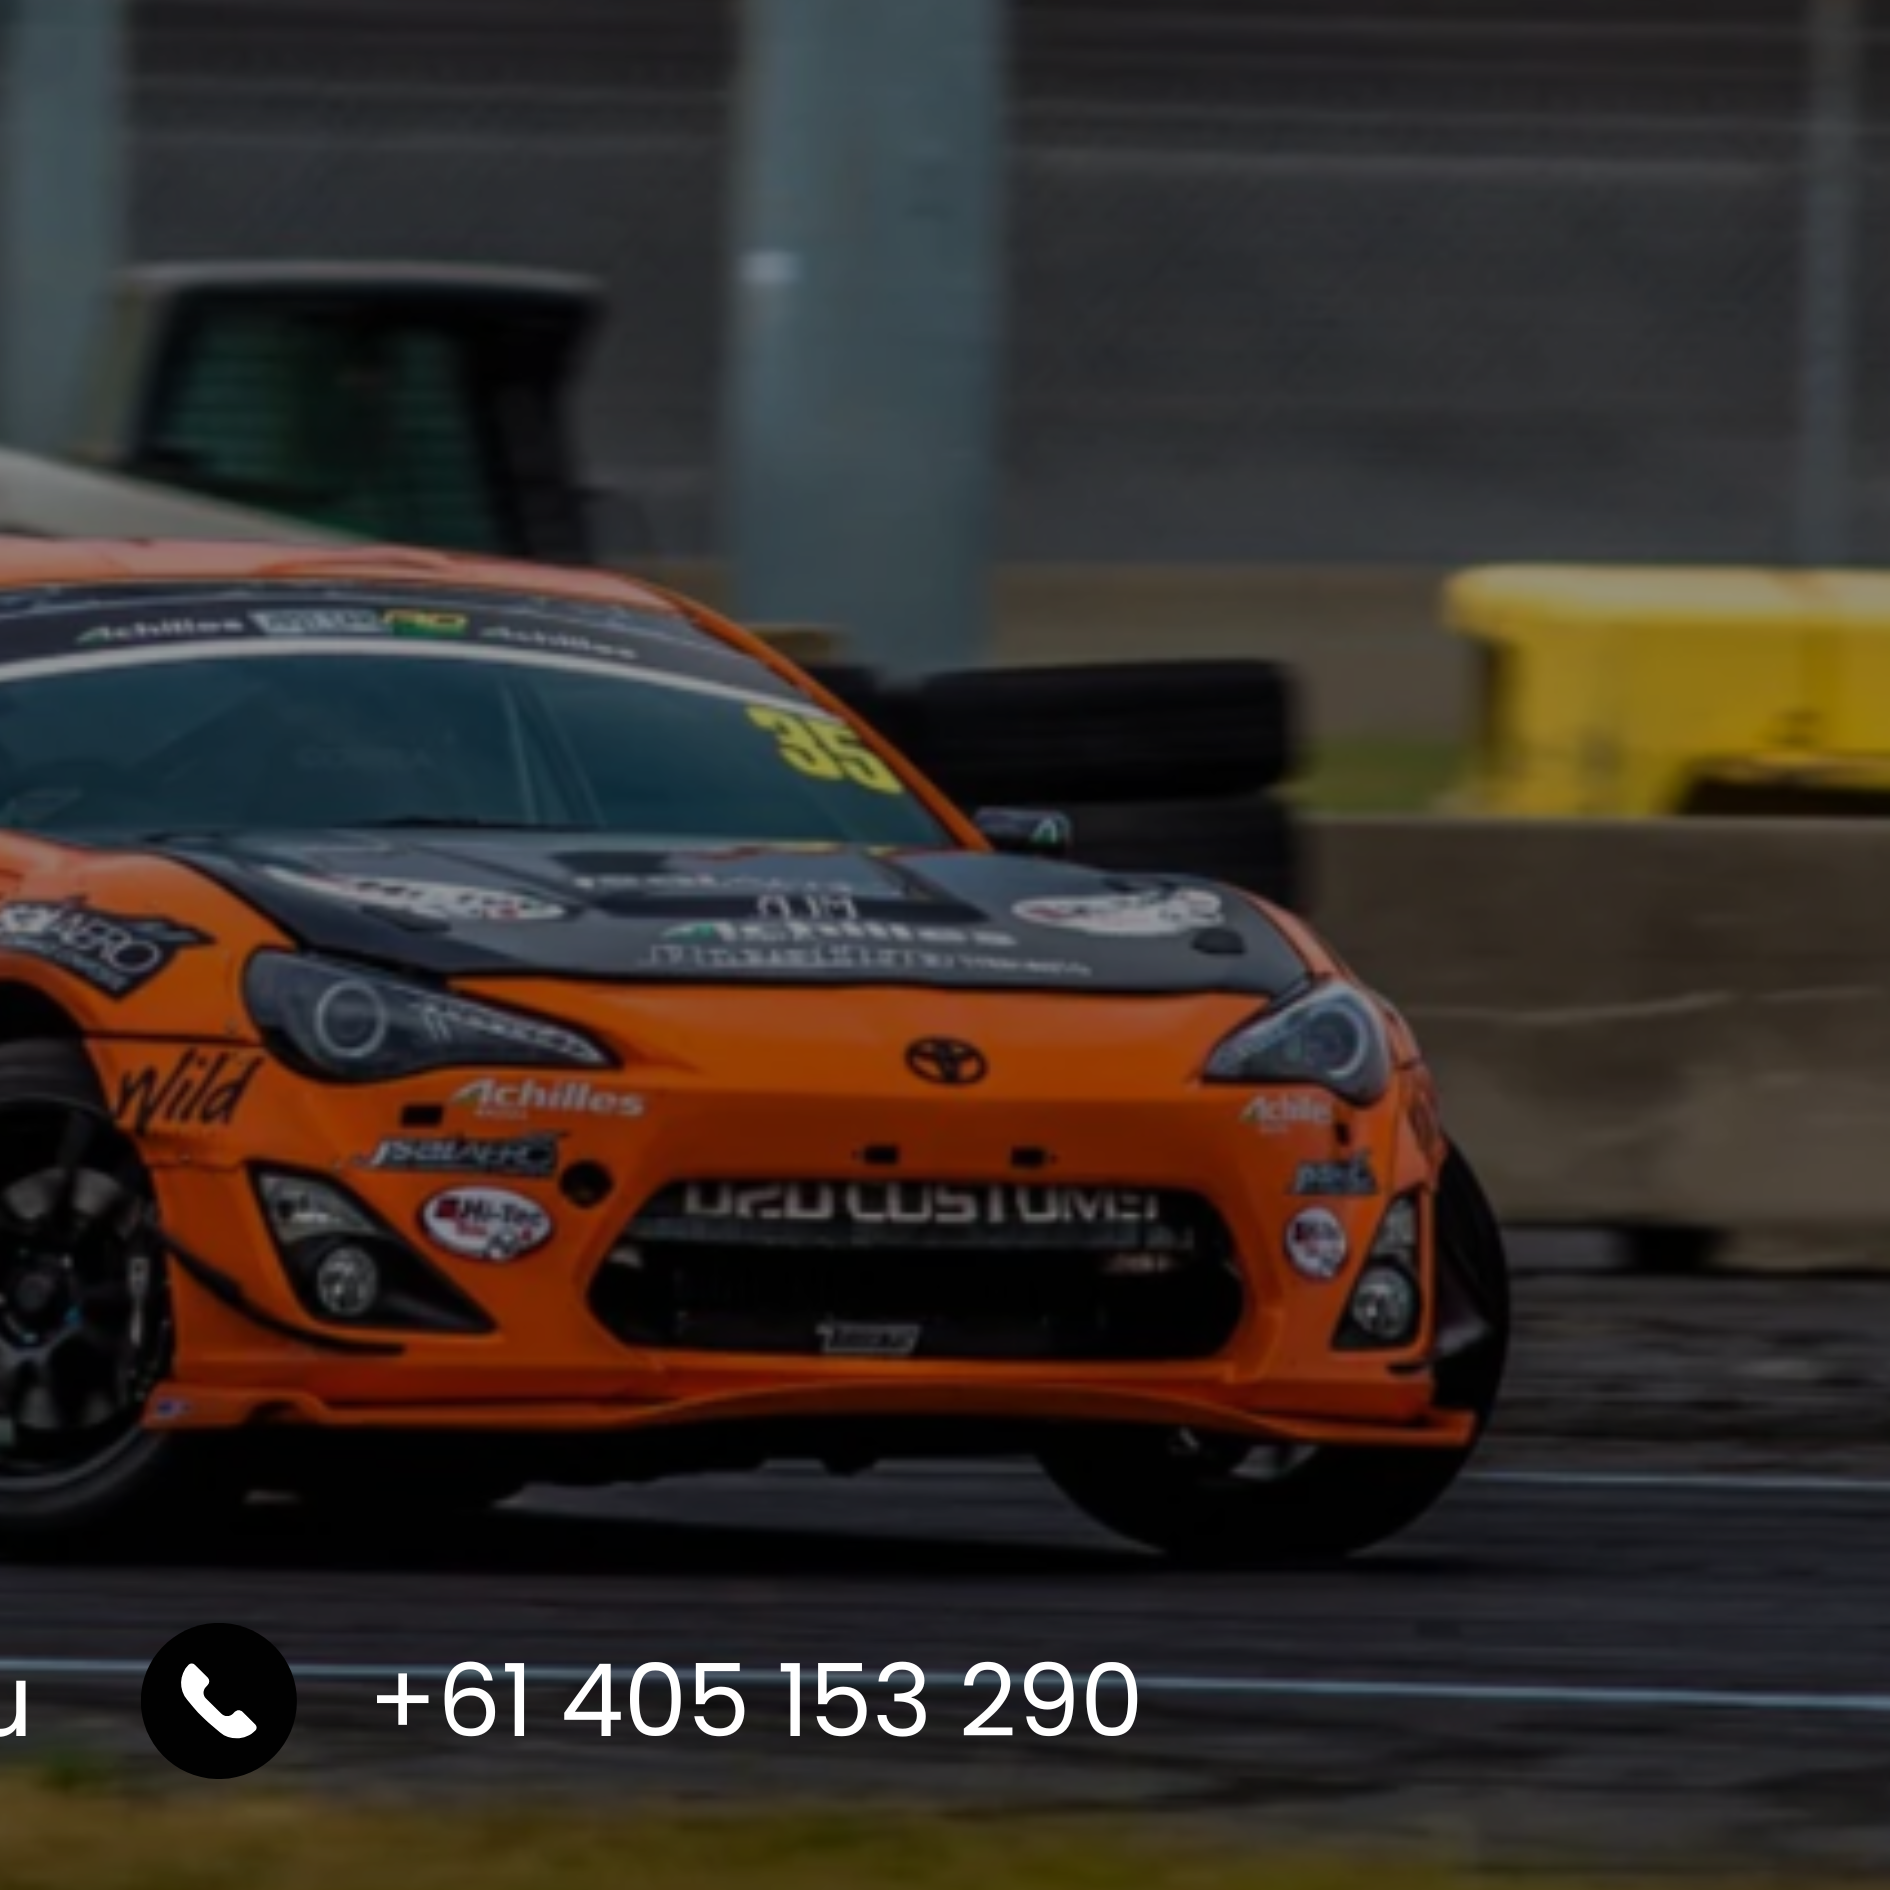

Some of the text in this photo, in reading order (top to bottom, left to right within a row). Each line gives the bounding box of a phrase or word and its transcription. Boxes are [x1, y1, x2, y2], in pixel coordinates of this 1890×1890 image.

[744, 703, 904, 795] 35
[116, 1046, 266, 1136] Wild
[452, 1078, 645, 1117] Achilles
